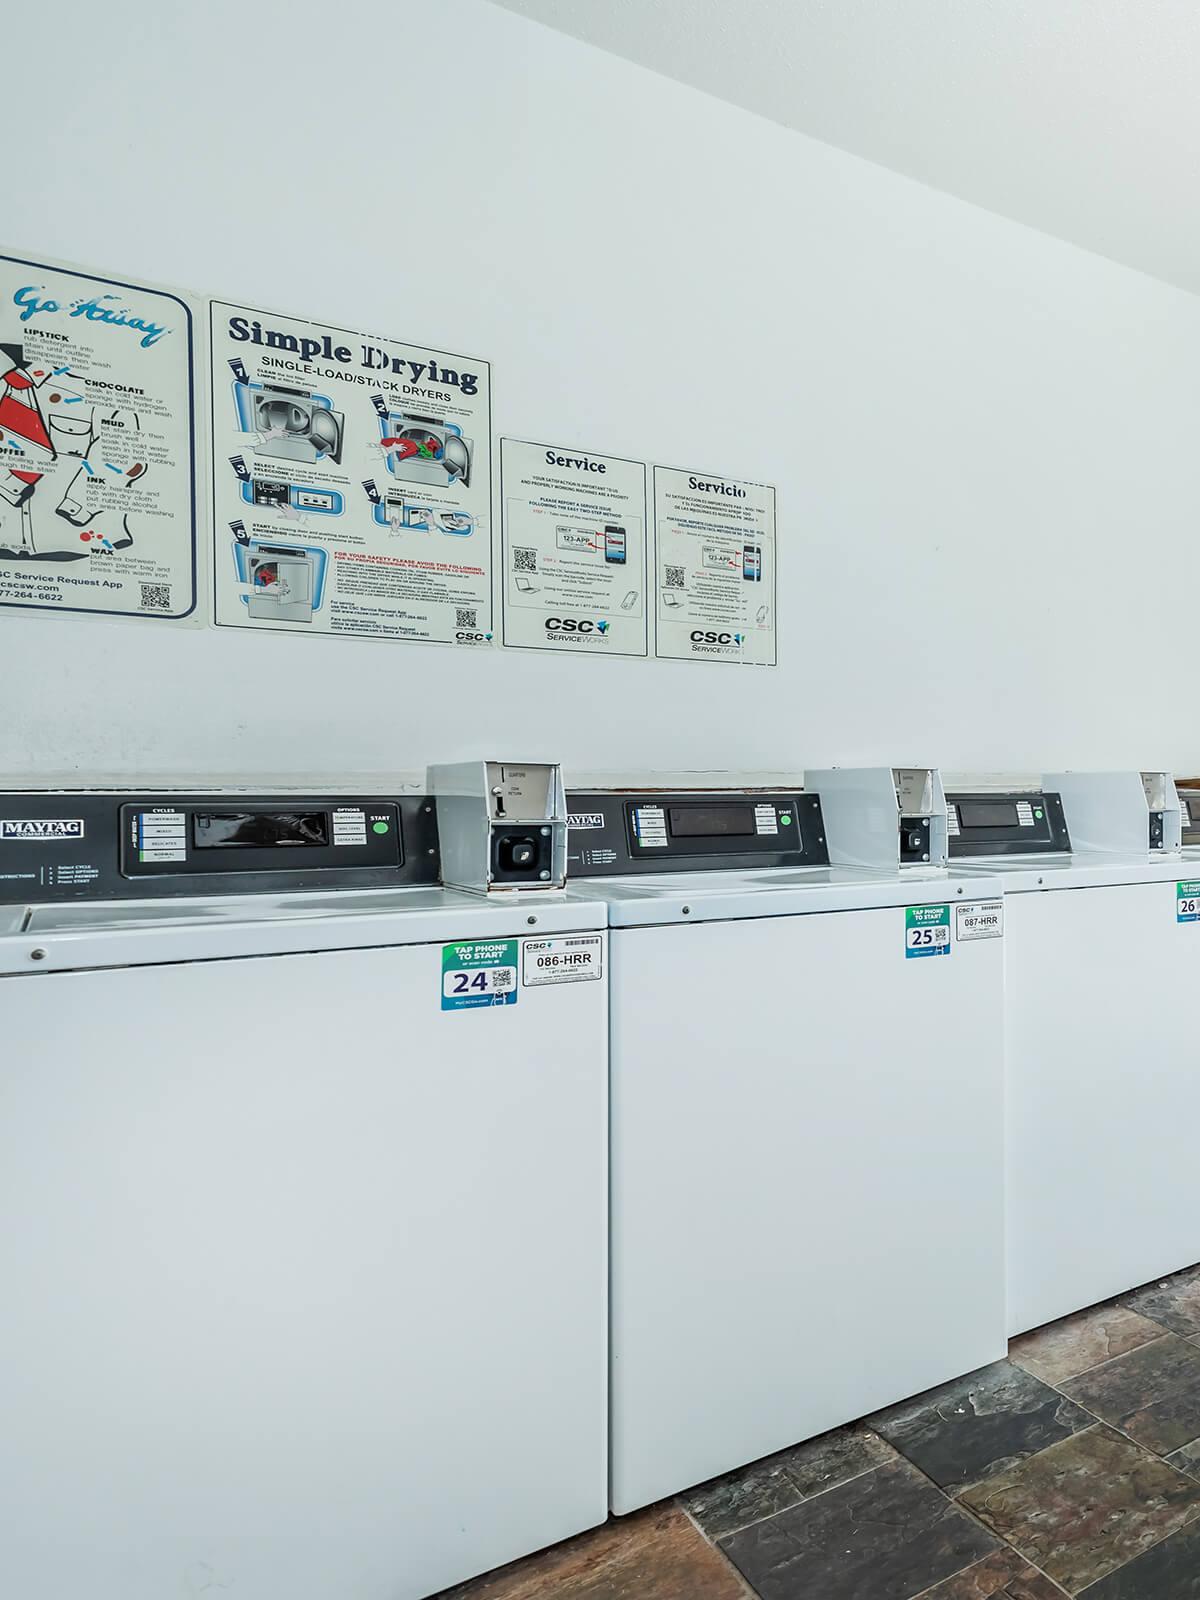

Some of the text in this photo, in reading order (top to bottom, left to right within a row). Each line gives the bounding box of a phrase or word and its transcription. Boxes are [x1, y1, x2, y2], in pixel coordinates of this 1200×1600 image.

[14, 286, 168, 348] Go Away
[24, 328, 69, 342] LIPSTICK
[25, 342, 91, 358] stain outline
[40, 338, 76, 350] detergent
[80, 345, 94, 353] into
[25, 348, 68, 361] disappears
[72, 356, 88, 364] then
[25, 354, 42, 362] with
[69, 362, 90, 370] water
[228, 316, 478, 396] Simple Drying
[236, 368, 243, 376] 1
[261, 356, 400, 393] SINGLE-LOAD/STACK
[402, 385, 452, 402] DRYERS
[85, 379, 144, 395] CHOCOLATE
[85, 400, 116, 409] peroxide
[86, 393, 112, 402] sponge
[134, 400, 168, 412] hydrogen
[134, 394, 152, 402] water
[378, 403, 386, 412] 2
[101, 418, 124, 428] MUD
[134, 430, 146, 438] dry
[148, 432, 164, 440] then
[102, 451, 128, 459] sponge
[150, 458, 176, 467] rubbing
[545, 450, 606, 474] Service
[236, 464, 246, 474] 3
[87, 476, 106, 484] INK
[546, 477, 577, 487] SATISFACTION
[582, 482, 606, 492] IMPORTANT
[110, 486, 143, 496] hairspray
[369, 488, 376, 497] 4
[532, 480, 554, 489] PROPERLY
[554, 484, 576, 493] WORKING
[576, 488, 598, 496] MACHINES
[688, 476, 746, 498] Servicio
[102, 498, 128, 506] rubbing
[132, 500, 158, 508] alcohol
[529, 500, 557, 509] FOLLOWING
[580, 508, 602, 516] TWO-STEP
[540, 496, 557, 504] PLEASE
[580, 502, 598, 510] SERVICE
[146, 510, 174, 518] washing
[237, 529, 246, 539] 5
[90, 548, 114, 556] WAX
[116, 562, 137, 570] paper
[140, 564, 154, 572] bag
[14, 572, 122, 588] Service Request App
[544, 617, 594, 633] CSC
[456, 632, 484, 641] CSC
[690, 630, 732, 645] CSC
[566, 816, 600, 824] AYTAG
[6, 822, 79, 832] MAYTAG
[1181, 900, 1195, 912] 26
[964, 916, 998, 926] 087-HRR
[912, 930, 932, 946] 25
[454, 944, 508, 954] TAP PHONE
[474, 952, 504, 960] START
[537, 954, 592, 967] 086-HRR
[453, 972, 488, 993] 24
